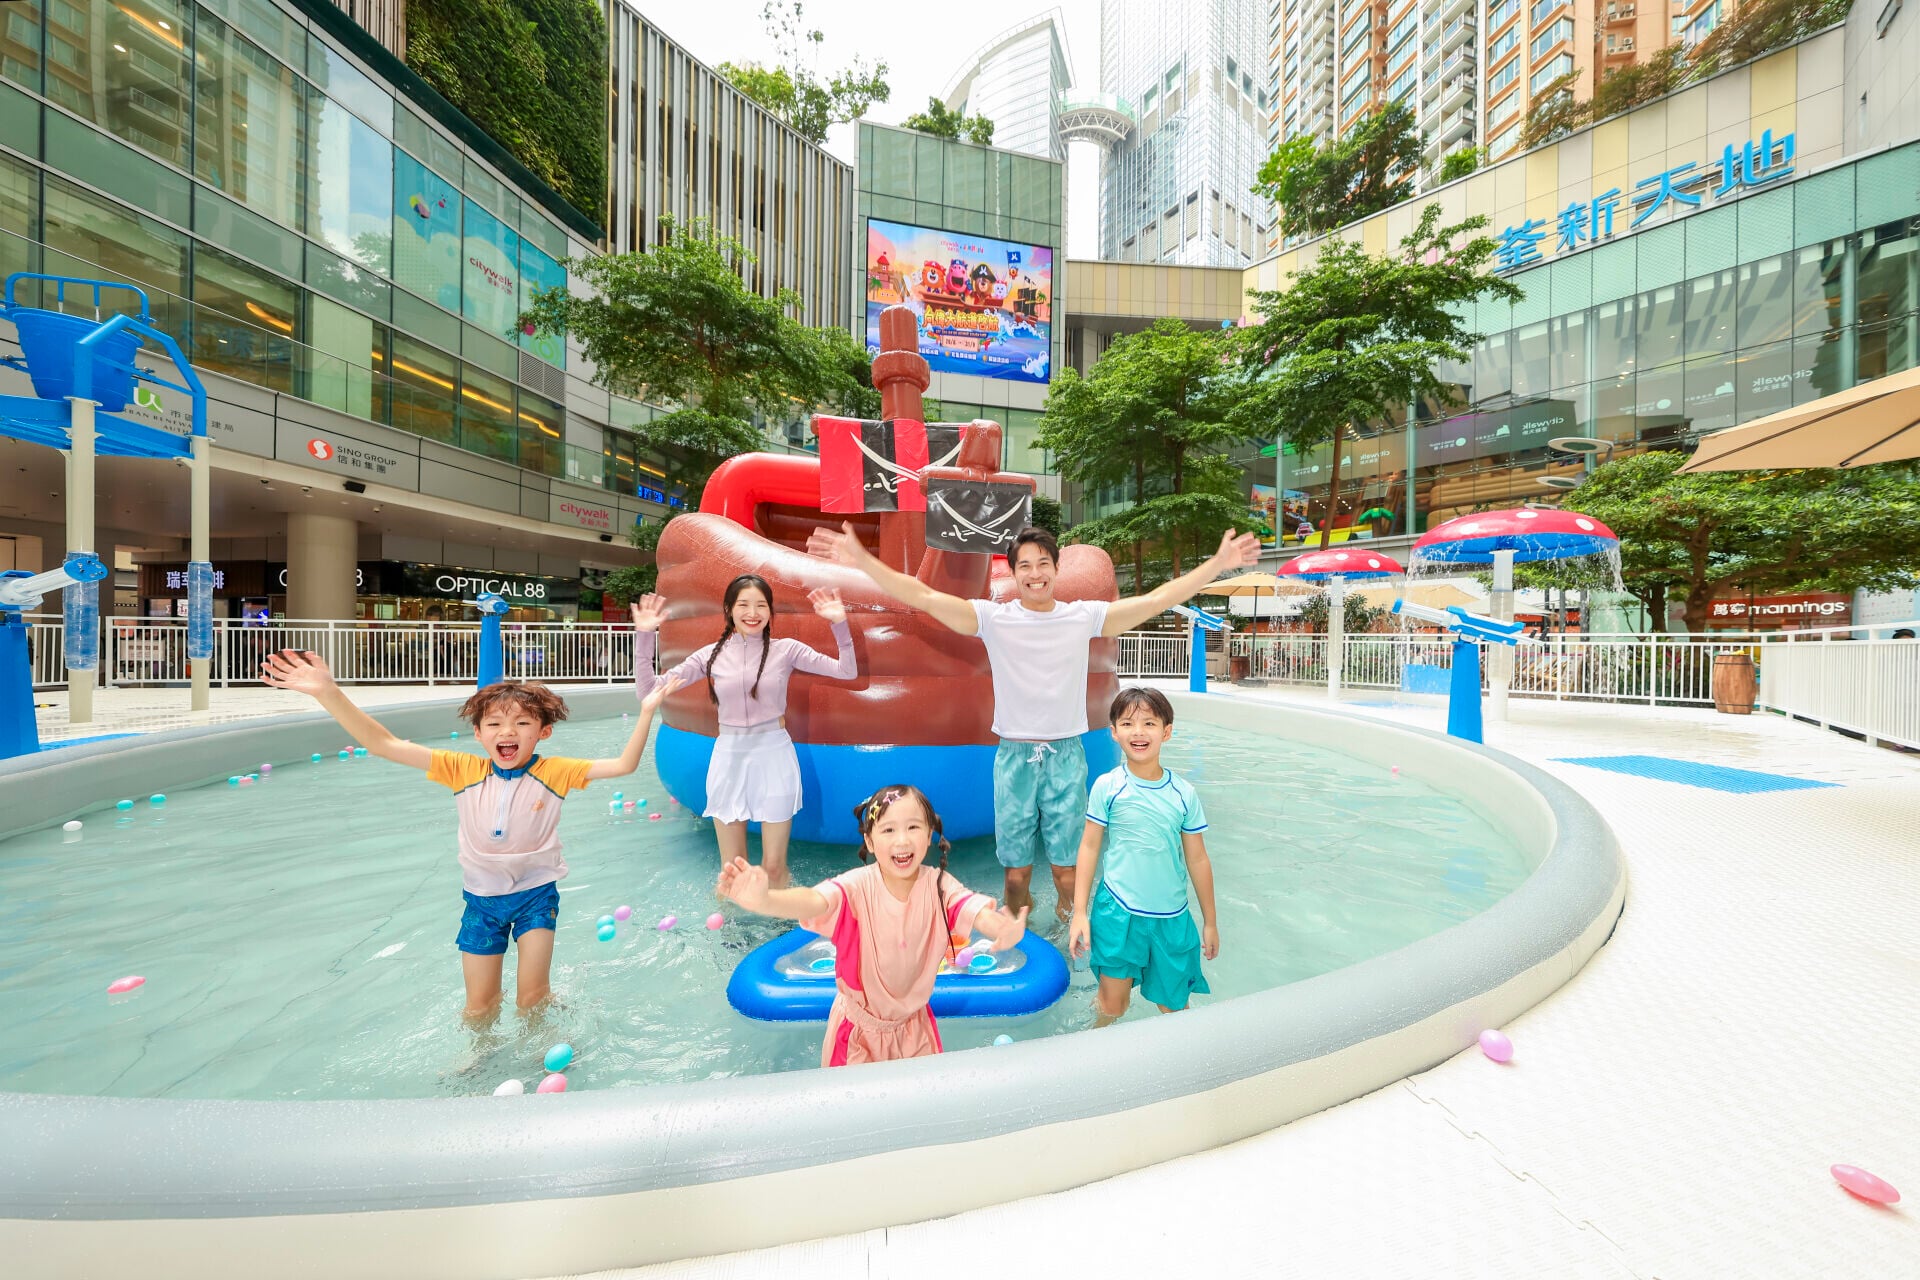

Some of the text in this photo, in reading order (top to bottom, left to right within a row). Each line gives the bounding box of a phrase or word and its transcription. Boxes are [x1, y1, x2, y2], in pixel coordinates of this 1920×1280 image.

[1492, 128, 1795, 273] 荃新天地
[469, 257, 513, 289] citywalk
[337, 445, 397, 467] SINO GROUP
[337, 454, 387, 474] 信和集團
[560, 502, 609, 520] citywalk
[435, 575, 545, 599] OPTICAL 88
[1747, 600, 1846, 616] mannings
